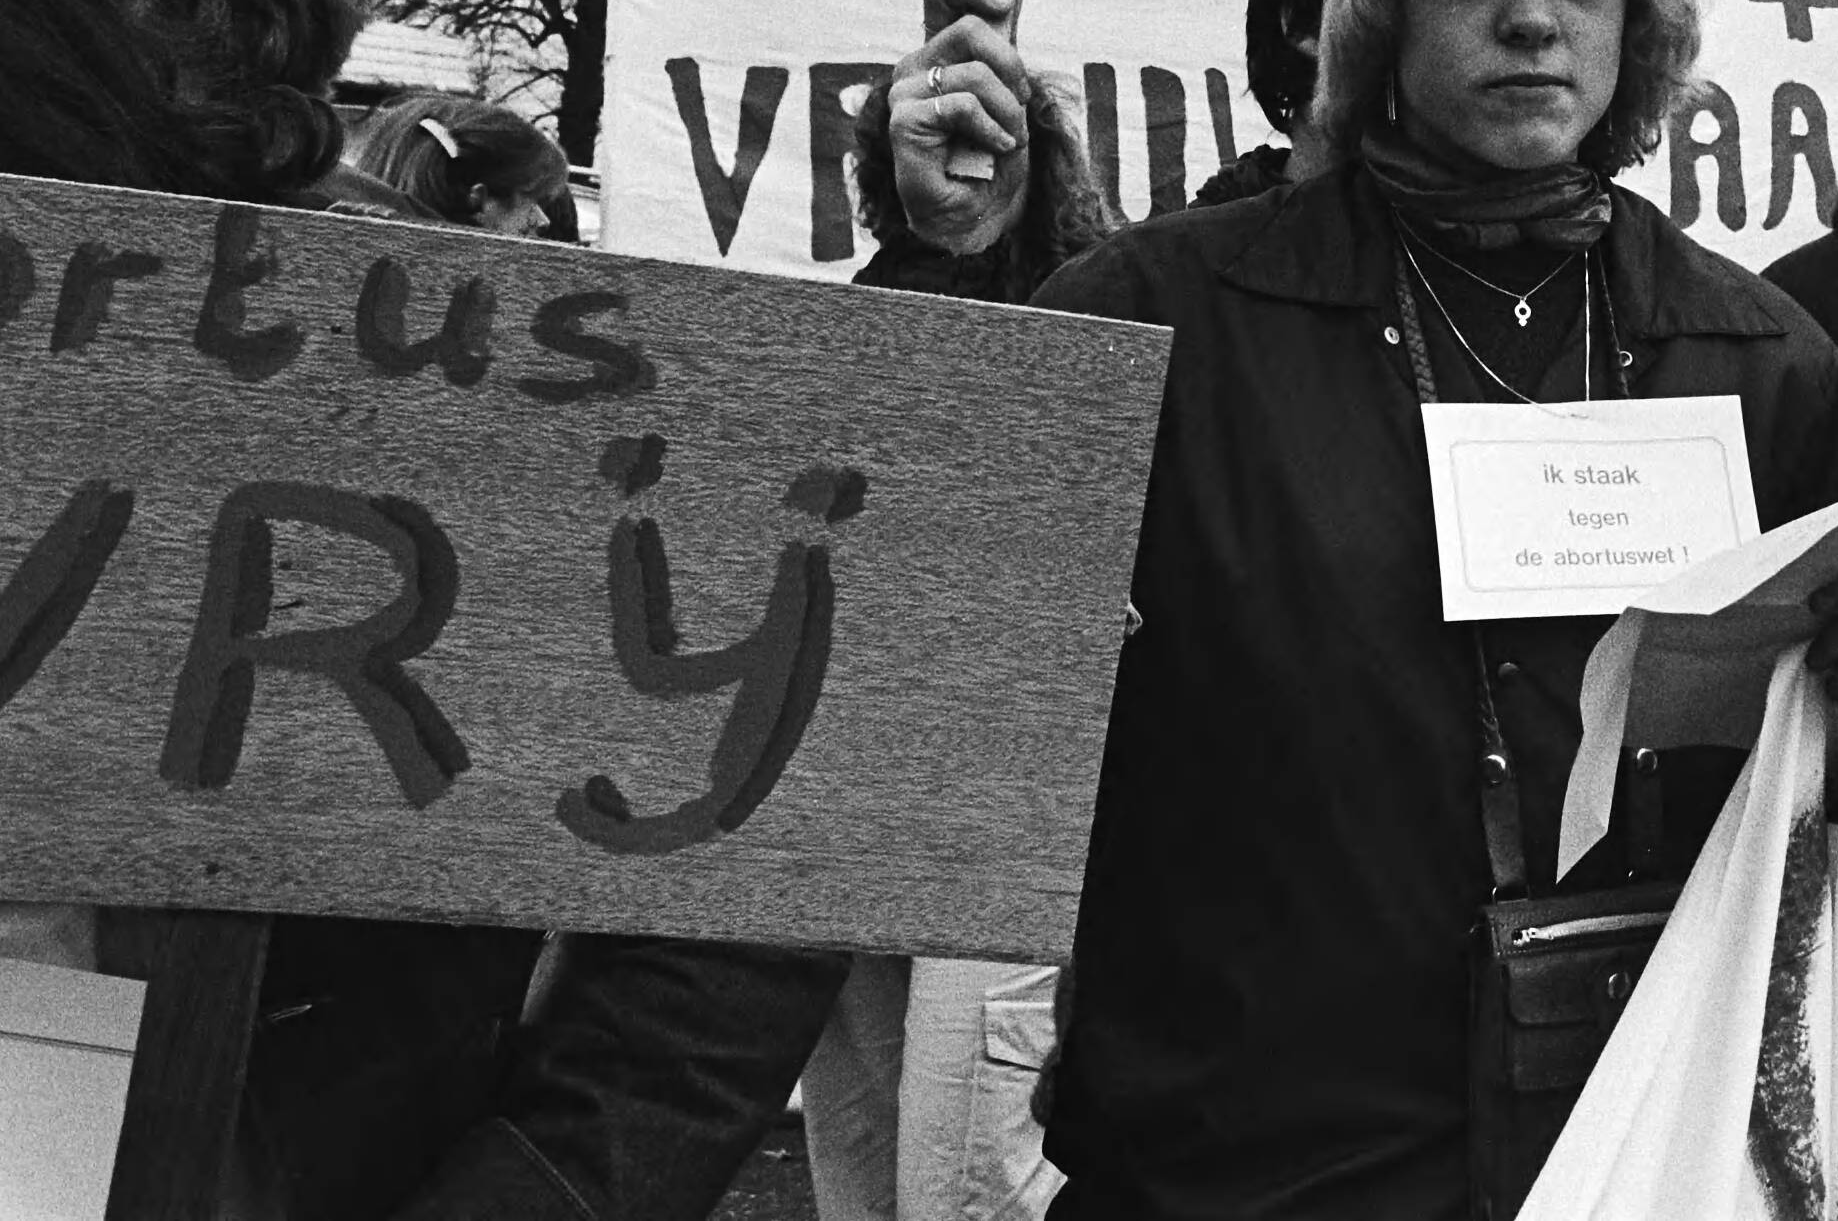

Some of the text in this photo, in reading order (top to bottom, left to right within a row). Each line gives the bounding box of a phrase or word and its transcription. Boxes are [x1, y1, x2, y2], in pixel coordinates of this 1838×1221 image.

[1543, 464, 1641, 485] ik staak
[1568, 509, 1630, 530] tegen
[1515, 548, 1543, 567] de
[1554, 546, 1676, 567] abortuswet
